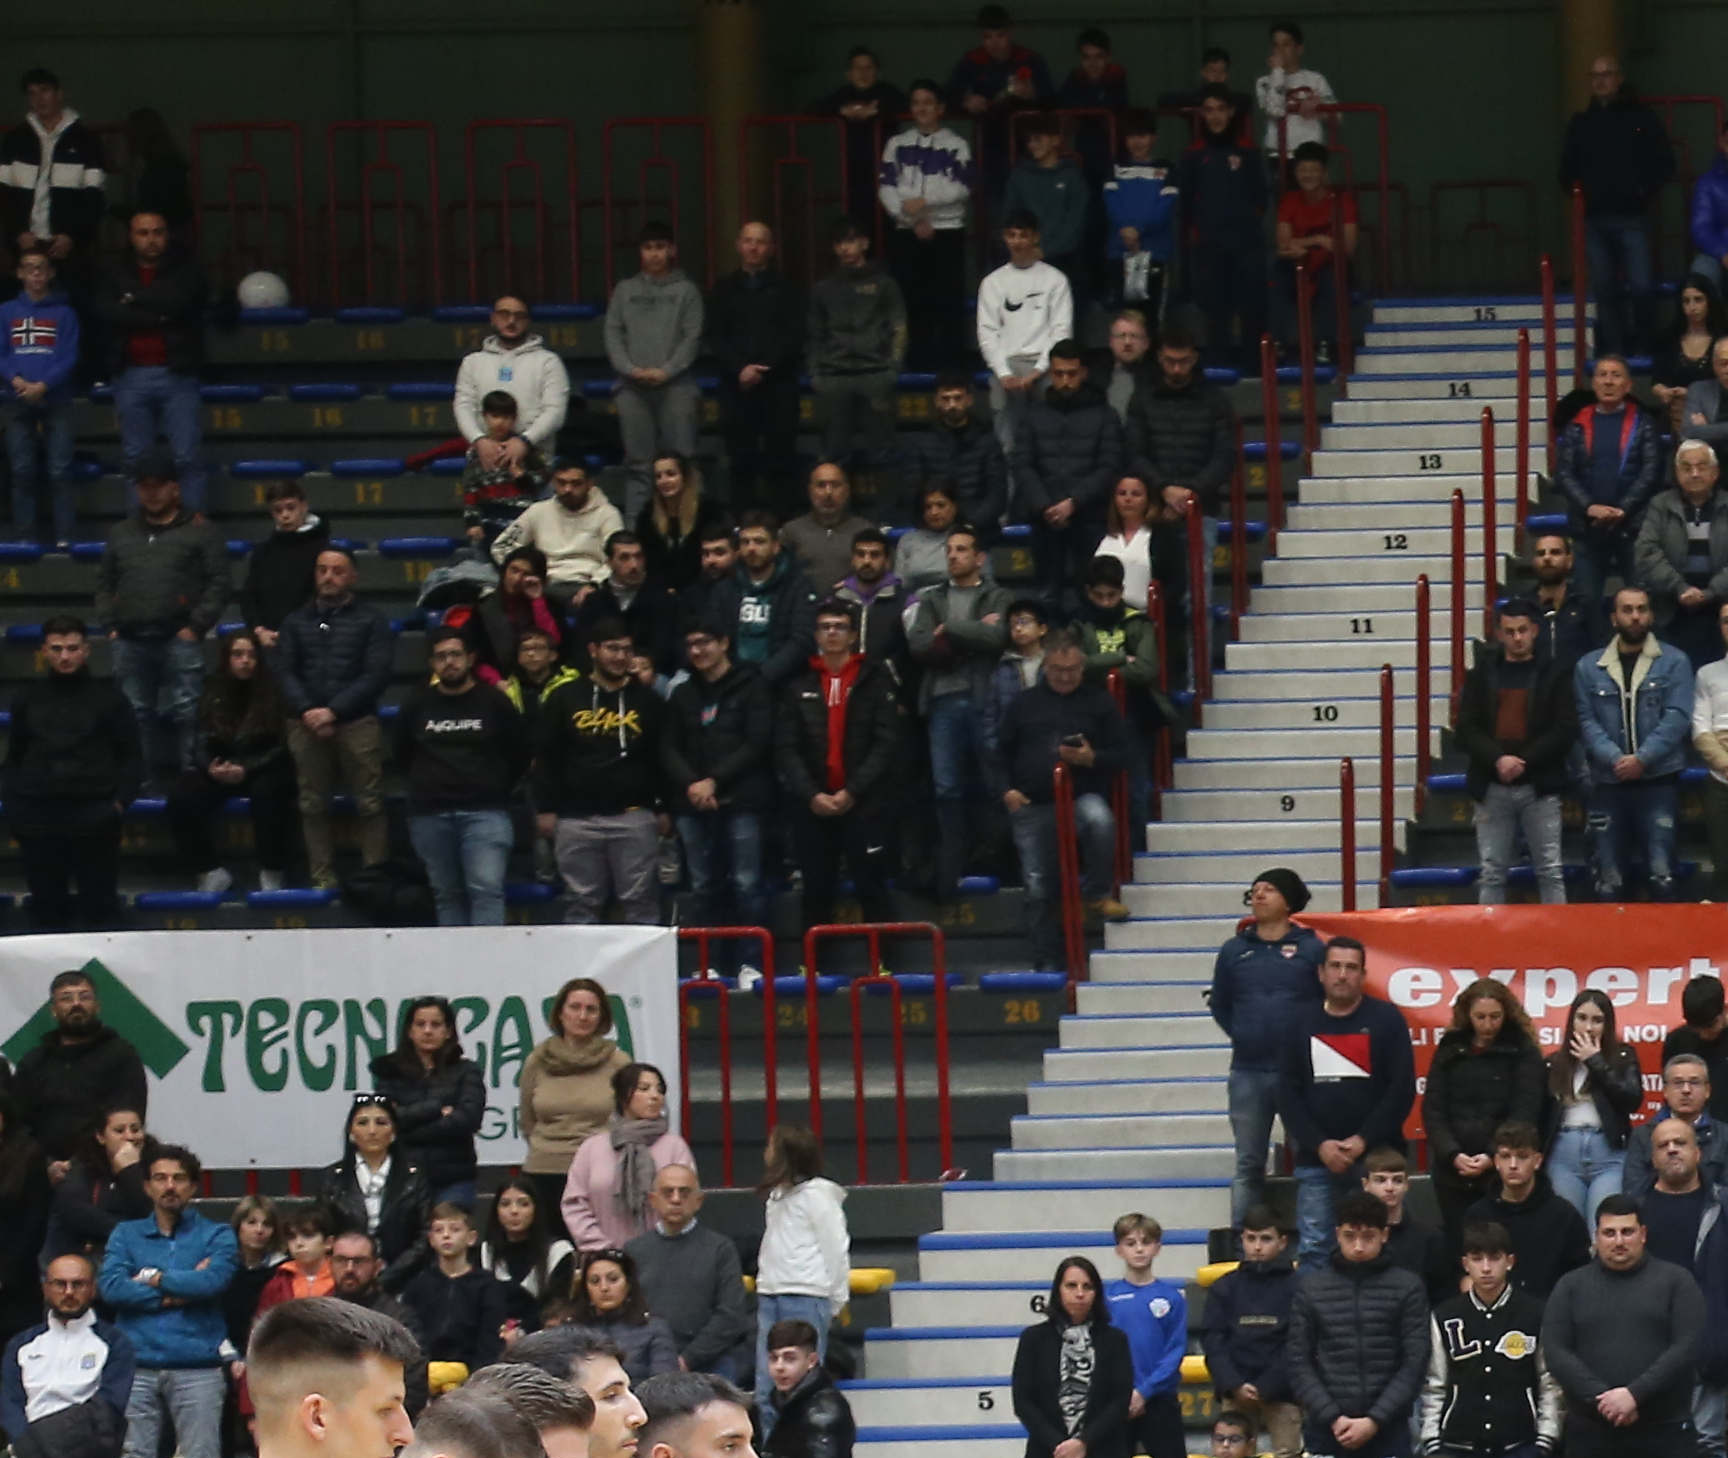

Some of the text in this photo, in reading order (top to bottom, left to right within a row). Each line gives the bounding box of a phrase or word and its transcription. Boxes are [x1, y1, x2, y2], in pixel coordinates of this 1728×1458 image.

[1474, 307, 1496, 322] 15
[1448, 382, 1471, 397] 14
[1418, 454, 1442, 470] 13
[1383, 534, 1408, 550] 12
[1350, 618, 1373, 634] 11
[1312, 706, 1338, 722] 10
[1280, 795, 1295, 812] 9
[977, 1391, 994, 1411] 5
